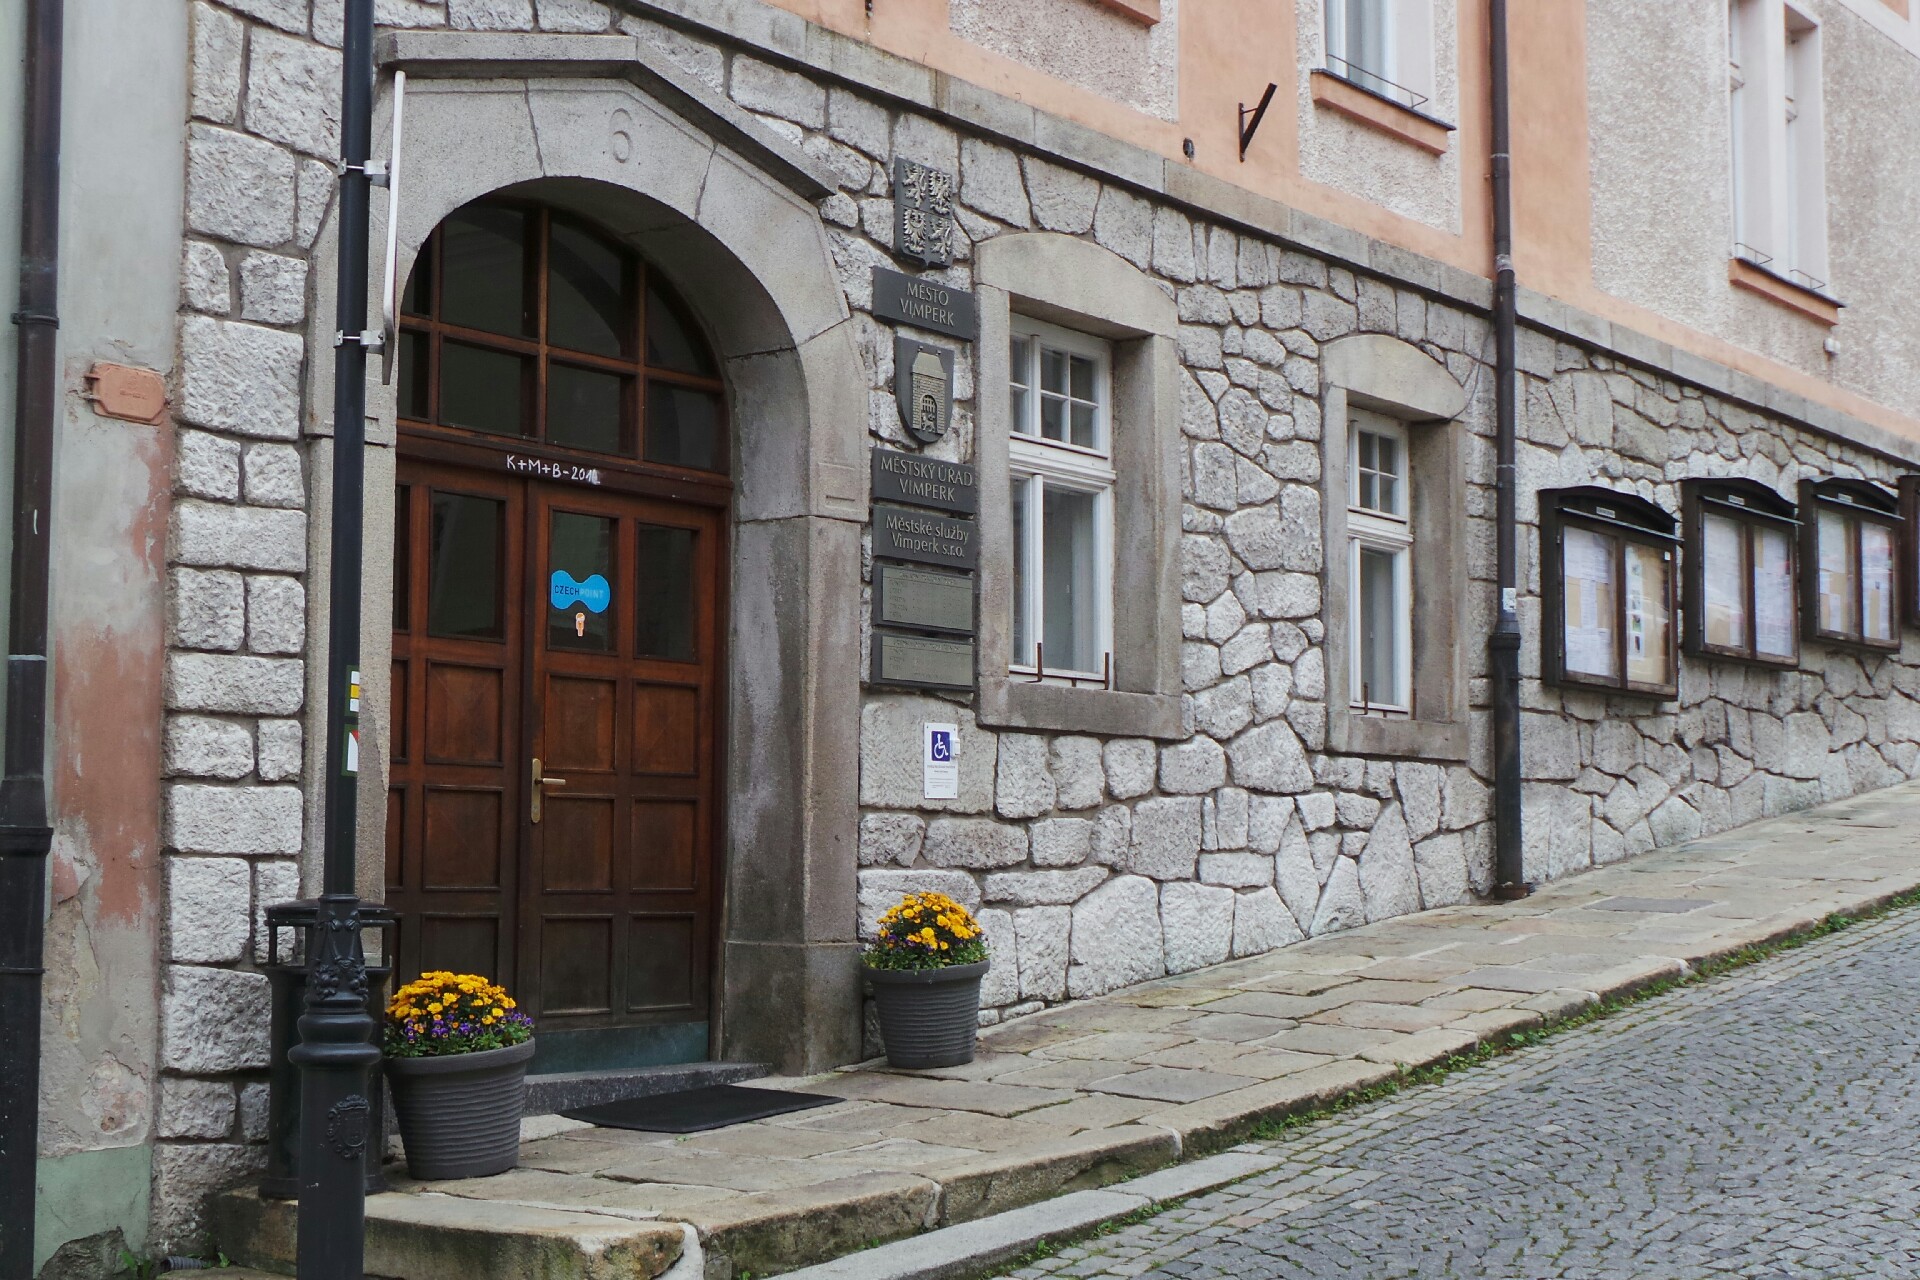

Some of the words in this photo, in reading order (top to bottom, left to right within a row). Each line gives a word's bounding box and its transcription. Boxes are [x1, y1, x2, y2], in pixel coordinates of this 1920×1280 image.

[900, 298, 954, 326] VIMPERK
[881, 456, 936, 480] MĚSTSKÝ
[938, 464, 973, 486] ÚŘAD
[899, 478, 955, 502] VIMPERK
[886, 515, 932, 536] Městské
[935, 522, 969, 545] služby
[891, 532, 939, 553] Vimperk
[942, 543, 965, 557] s.r.o.
